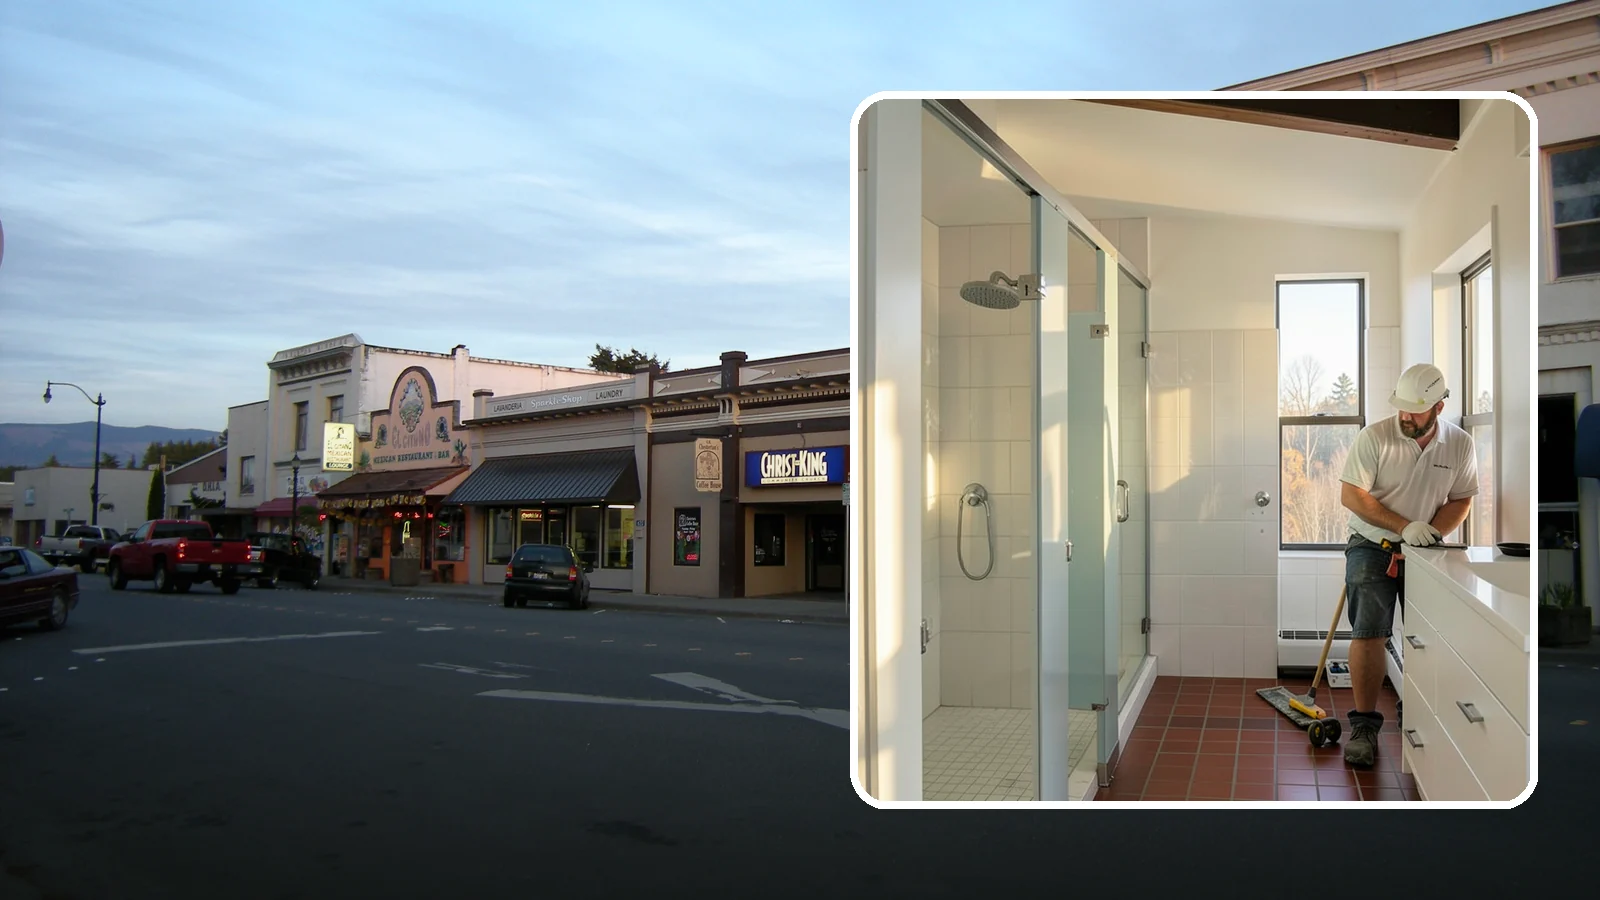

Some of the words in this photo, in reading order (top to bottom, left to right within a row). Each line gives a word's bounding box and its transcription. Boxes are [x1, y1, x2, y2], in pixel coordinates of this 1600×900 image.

[562, 395, 582, 404] Shop
[595, 389, 623, 400] LAUNDRY
[493, 402, 522, 412] LAVANDERIA
[373, 455, 396, 464] MEXICAN
[398, 452, 433, 462] RESTAURANT
[438, 450, 449, 459] BAR
[761, 452, 797, 478] CHRIST
[799, 450, 827, 476] KING
